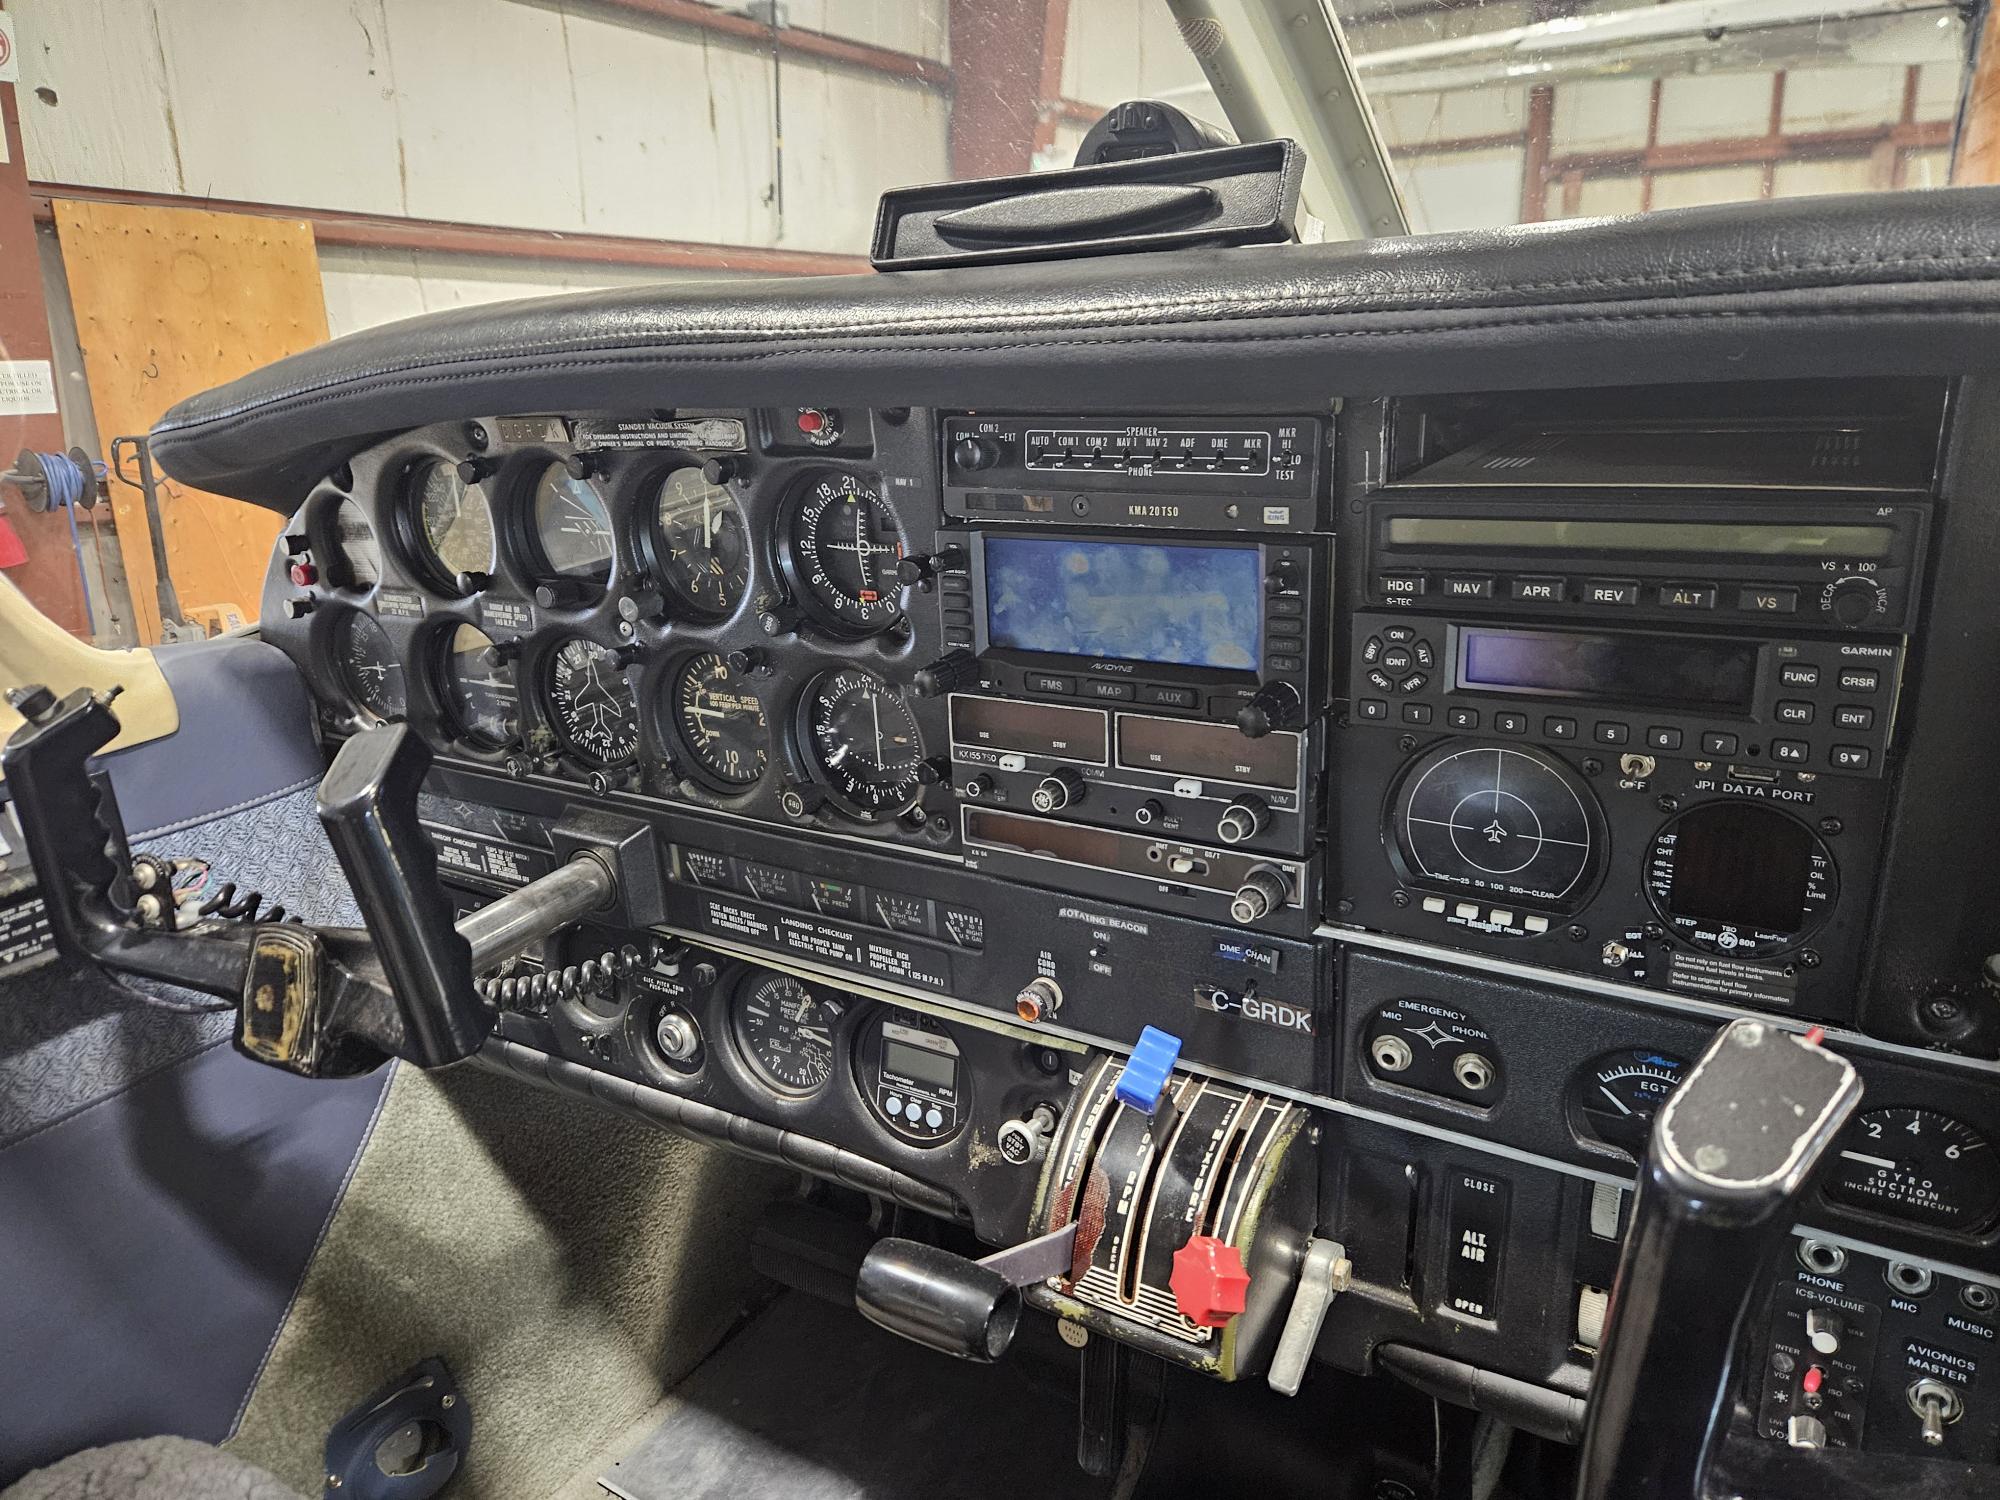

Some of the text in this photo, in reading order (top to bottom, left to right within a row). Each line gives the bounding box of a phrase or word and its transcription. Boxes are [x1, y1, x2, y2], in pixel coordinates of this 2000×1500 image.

[979, 424, 994, 432] COM
[1126, 427, 1158, 436] SPEAKER
[1279, 428, 1296, 438] MKR
[810, 431, 839, 446] WARNING
[1005, 433, 1016, 441] EXT
[1031, 436, 1049, 445] AUTO
[1058, 437, 1073, 446] COM
[1085, 437, 1101, 446] COM
[1116, 438, 1132, 447] NAV
[1146, 438, 1162, 447] NAV
[1180, 438, 1195, 448] ADF
[1211, 438, 1228, 448] DME
[1244, 438, 1261, 448] MKR
[1282, 440, 1291, 449] HI
[1291, 455, 1301, 465] LO
[1128, 467, 1153, 477] PHONE
[1275, 470, 1295, 480] TEST
[842, 476, 856, 489] 21
[816, 483, 831, 500] 18
[801, 505, 815, 523] 15
[1129, 506, 1179, 516] KMA 20 TSO
[1877, 507, 1892, 516] AP
[800, 540, 811, 556] 12
[1821, 561, 1876, 572] VS 100
[1387, 580, 1413, 591] HDG
[1453, 583, 1480, 594] NAV
[1523, 586, 1550, 597] APR
[1386, 597, 1412, 606] S-TEC
[1594, 590, 1623, 601] REV
[1673, 592, 1701, 604] ALT
[1821, 583, 1837, 611] DECR
[1875, 587, 1888, 613] INCR
[1757, 597, 1777, 609] VS
[1390, 631, 1404, 639] ON
[1365, 643, 1377, 660] SBY
[1417, 648, 1429, 664] ALT
[1840, 646, 1893, 657] GARMIN
[1090, 662, 1133, 673] AVIDYNE
[1386, 657, 1406, 667] IDNT
[835, 675, 847, 689] 21
[860, 673, 872, 683] 24
[1371, 673, 1388, 688] OFF
[1784, 671, 1816, 683] FUNC
[1842, 676, 1875, 687] CRSR
[1040, 679, 1063, 691] FMS
[1404, 678, 1421, 691] VFR
[1097, 685, 1122, 697] MAP
[1157, 691, 1182, 703] AUX
[709, 692, 759, 706] VERTICAL SPEED
[1783, 708, 1806, 719] CLR
[1841, 713, 1865, 724] ENT
[816, 724, 826, 736] 15
[725, 749, 739, 764] 10
[969, 751, 981, 760] 155
[1150, 754, 1161, 762] USE
[1235, 765, 1251, 774] STBY
[1694, 780, 1814, 802] JPI DATA PORT
[1270, 794, 1289, 804] NAV
[1658, 836, 1676, 845] EGT
[1656, 847, 1674, 856] CHT
[1812, 859, 1827, 868] TIT
[1810, 871, 1825, 880] OIL
[1434, 872, 1450, 881] TIME
[1460, 877, 1470, 885] 25
[1490, 882, 1504, 891] 100
[1509, 886, 1524, 894] 200
[1531, 889, 1555, 900] CLEAR
[1806, 890, 1826, 900] Limit
[1058, 908, 1149, 934] ROTATING BEACON
[1467, 917, 1502, 934] Insight
[1675, 917, 1698, 926] STEP
[780, 917, 853, 941] LANDING CHECKLIST
[1721, 924, 1737, 933] TSO
[787, 931, 846, 952] FUEL PROPER TANK
[1625, 931, 1642, 940] EGT
[1694, 930, 1717, 941] EDM
[789, 938, 828, 956] ELECTRIC FUEL
[868, 944, 909, 961] MIXTURE RICH
[1040, 951, 1052, 960] AIR
[1219, 943, 1271, 964] DME CHAN
[869, 952, 912, 970] PROPELLER SET
[869, 960, 905, 976] FLAPS DOWN
[1745, 966, 1783, 977] instruments
[1672, 971, 1748, 989] Refer original flow
[1672, 979, 1790, 1003] instrumentation primary information
[1211, 991, 1312, 1033] C-GRDK
[1382, 1010, 1402, 1021] MIC
[1398, 1000, 1466, 1021] EMERGENCY
[1650, 1056, 1680, 1068] Alcor
[882, 1071, 915, 1086] Tachometer
[938, 1087, 953, 1098] RPM
[1640, 1080, 1669, 1094] EGT
[1868, 1122, 1883, 1139] 2
[1905, 1120, 1921, 1135] 4
[1005, 1143, 1021, 1156] VAC
[1006, 1137, 1025, 1151] STBY
[1944, 1144, 1960, 1159] 6
[1185, 1128, 1224, 1222] MIXTURE
[1877, 1169, 1933, 1189] GYRO
[1463, 1177, 1496, 1194] CLOSE
[1868, 1177, 1939, 1201] SUCTION
[1116, 1170, 1137, 1215] RPM
[1844, 1181, 1960, 1215] INCHES OF MERCURY
[1462, 1229, 1488, 1248] ALT.
[1461, 1244, 1486, 1263] AIR
[1798, 1272, 1845, 1292] PHONE
[1795, 1287, 1865, 1313] ICS-VOLUME
[1455, 1298, 1483, 1315] OPEN
[1891, 1299, 1918, 1314] MIC
[1948, 1317, 1994, 1339] MUSIC
[1906, 1343, 1976, 1371] AVIONICS
[1832, 1360, 1858, 1372] PILOT
[1907, 1356, 1968, 1383] MASTER
[1773, 1371, 1791, 1381] VOX
[1828, 1388, 1843, 1397] ISO
